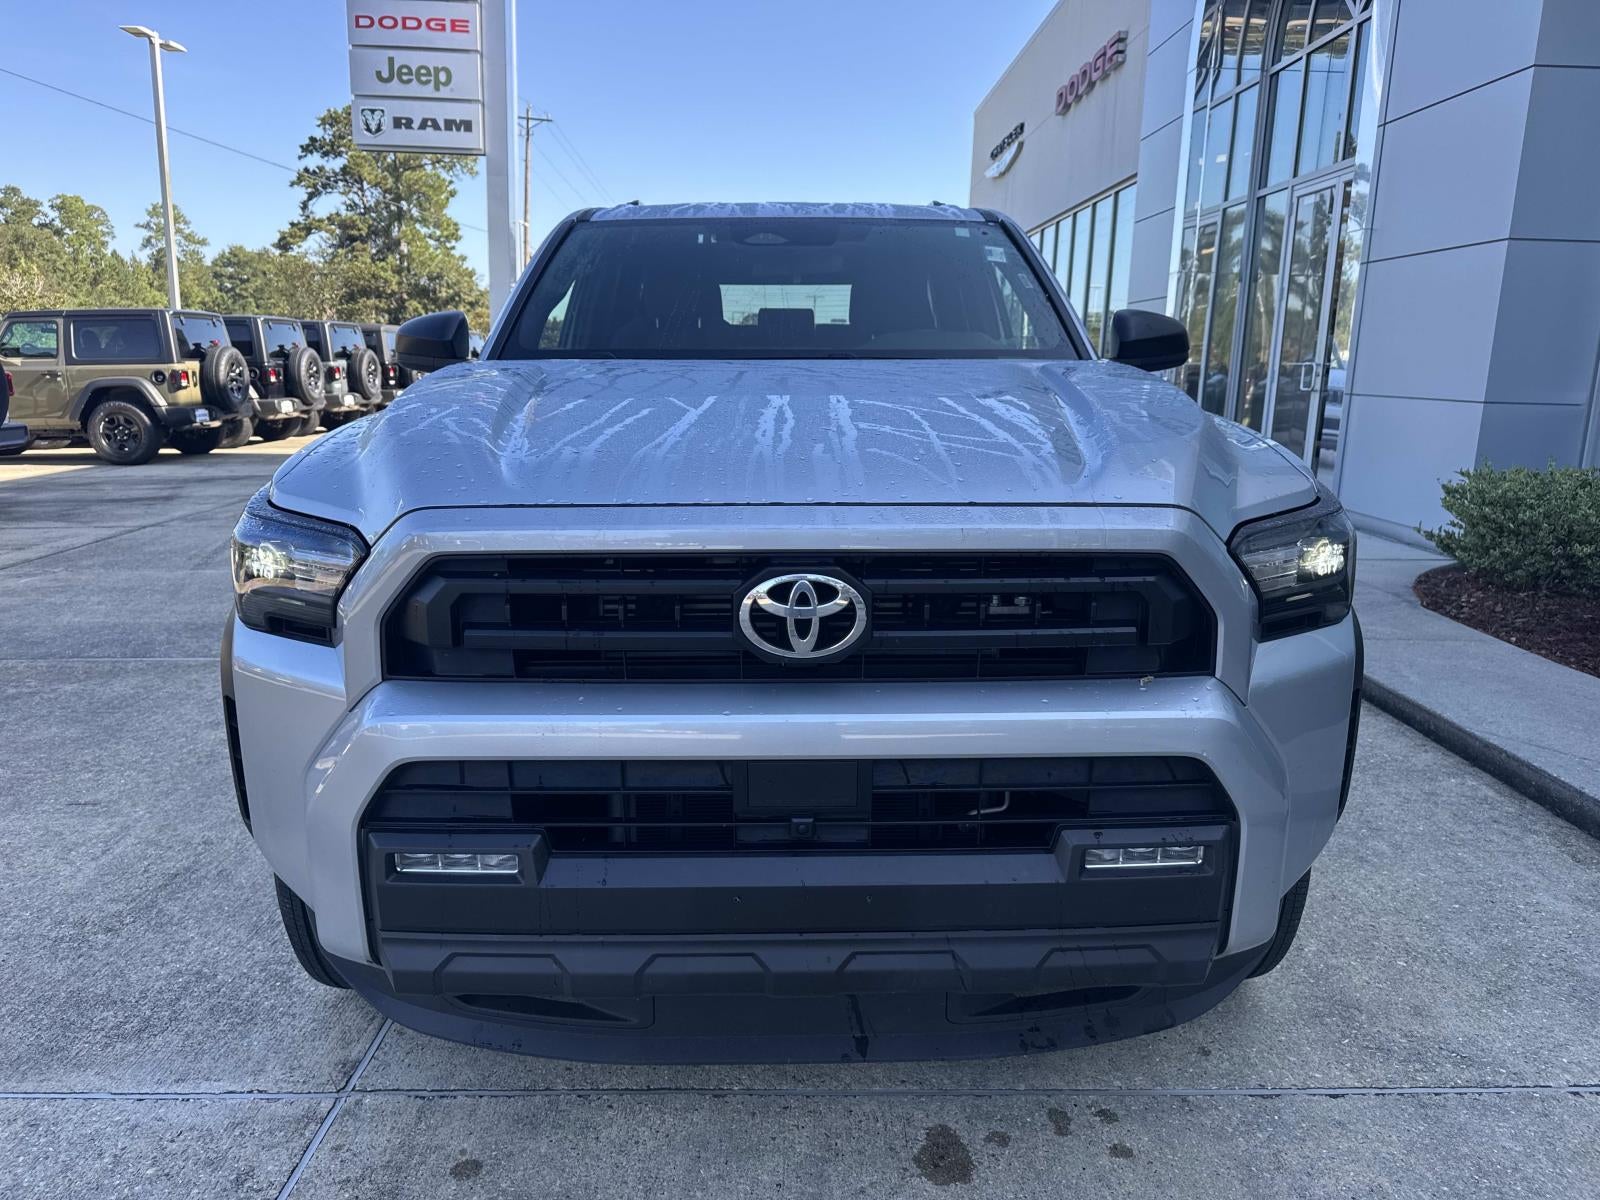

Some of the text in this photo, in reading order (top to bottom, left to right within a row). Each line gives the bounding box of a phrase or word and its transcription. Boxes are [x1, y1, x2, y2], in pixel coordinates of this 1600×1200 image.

[354, 15, 470, 33] DODGE
[375, 56, 453, 92] Jeep
[1055, 30, 1129, 116] DODGE
[392, 116, 473, 133] RAM
